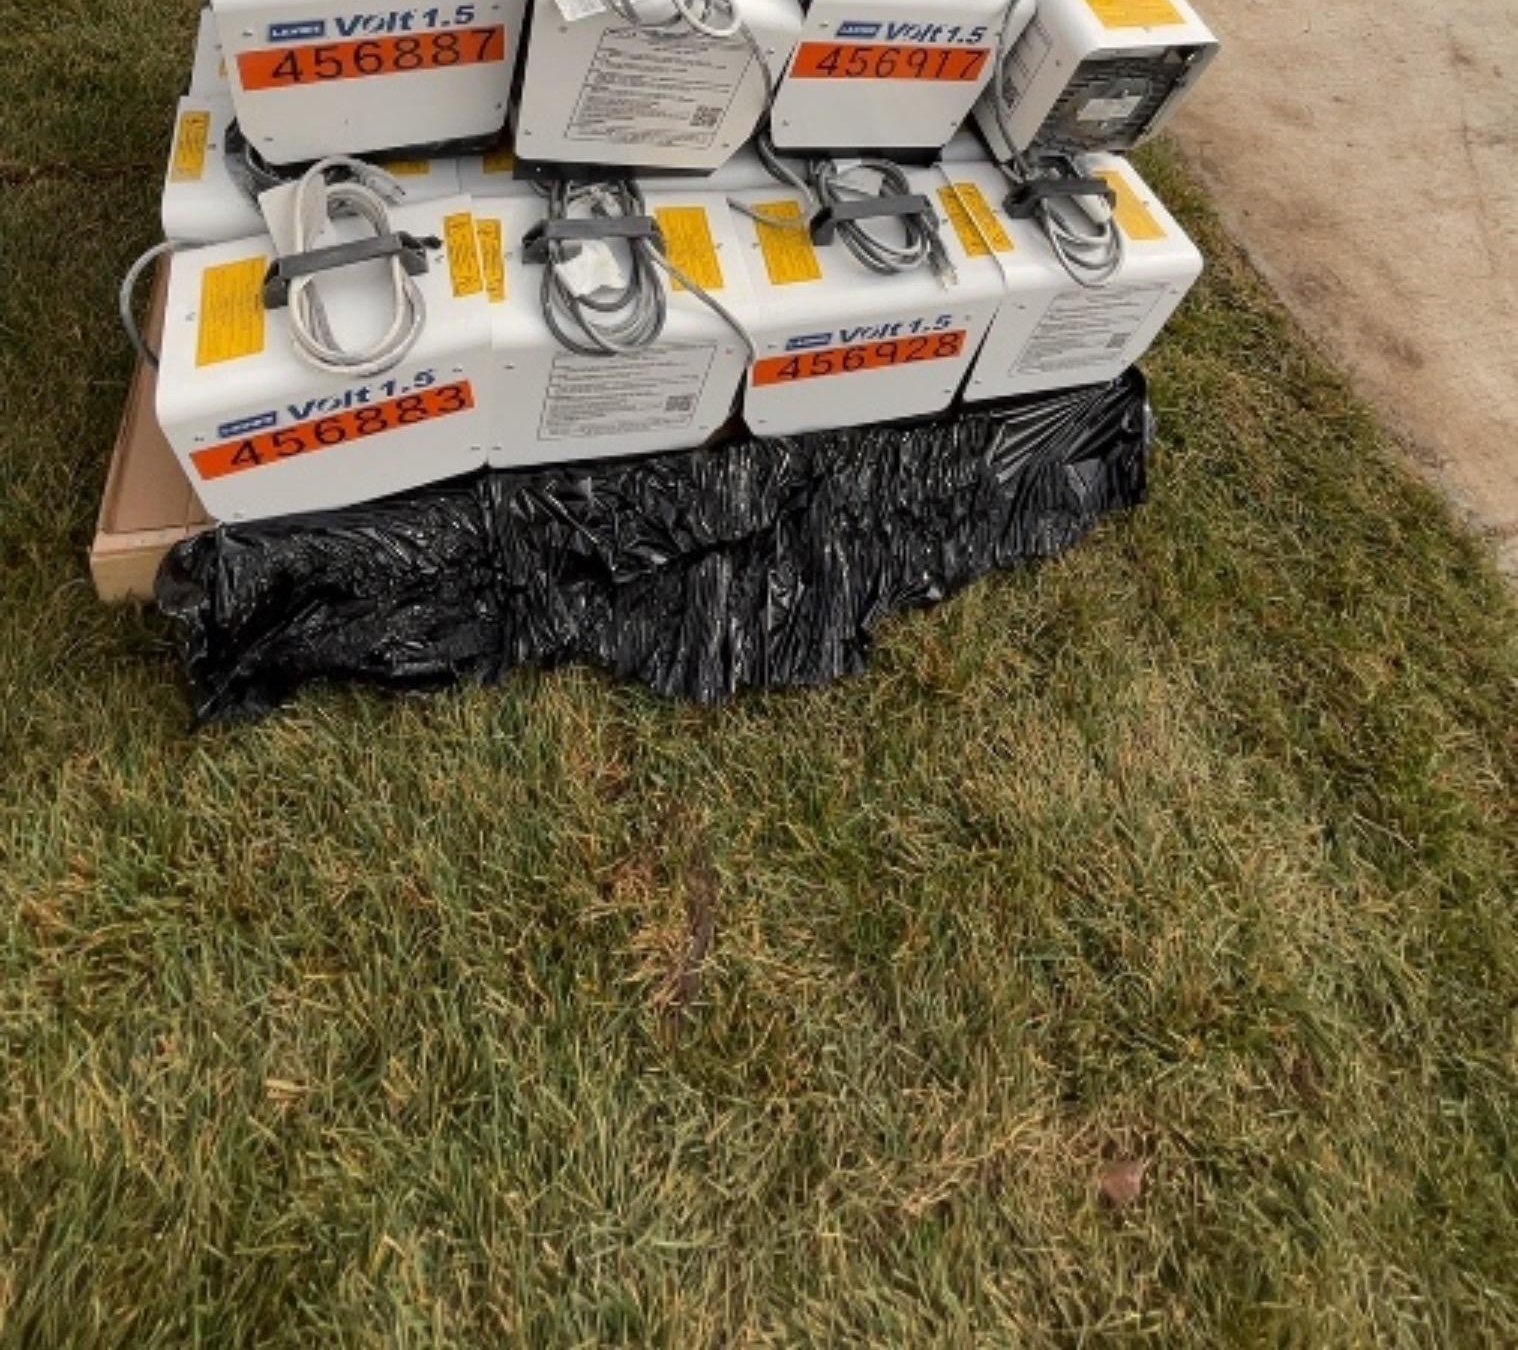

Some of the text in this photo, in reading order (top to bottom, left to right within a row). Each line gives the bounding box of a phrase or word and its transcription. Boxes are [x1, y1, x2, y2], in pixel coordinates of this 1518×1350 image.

[334, 8, 416, 37] Volt
[421, 4, 476, 27] 1.5
[886, 22, 943, 42] Volt
[946, 26, 987, 43] 1.5
[271, 29, 497, 83] 456887
[815, 47, 984, 79] 456917
[838, 322, 903, 342] Volt
[907, 314, 953, 334] 1.5
[777, 333, 960, 378] 456928
[287, 368, 436, 421] Volt 1.5
[231, 386, 467, 465] 456883
